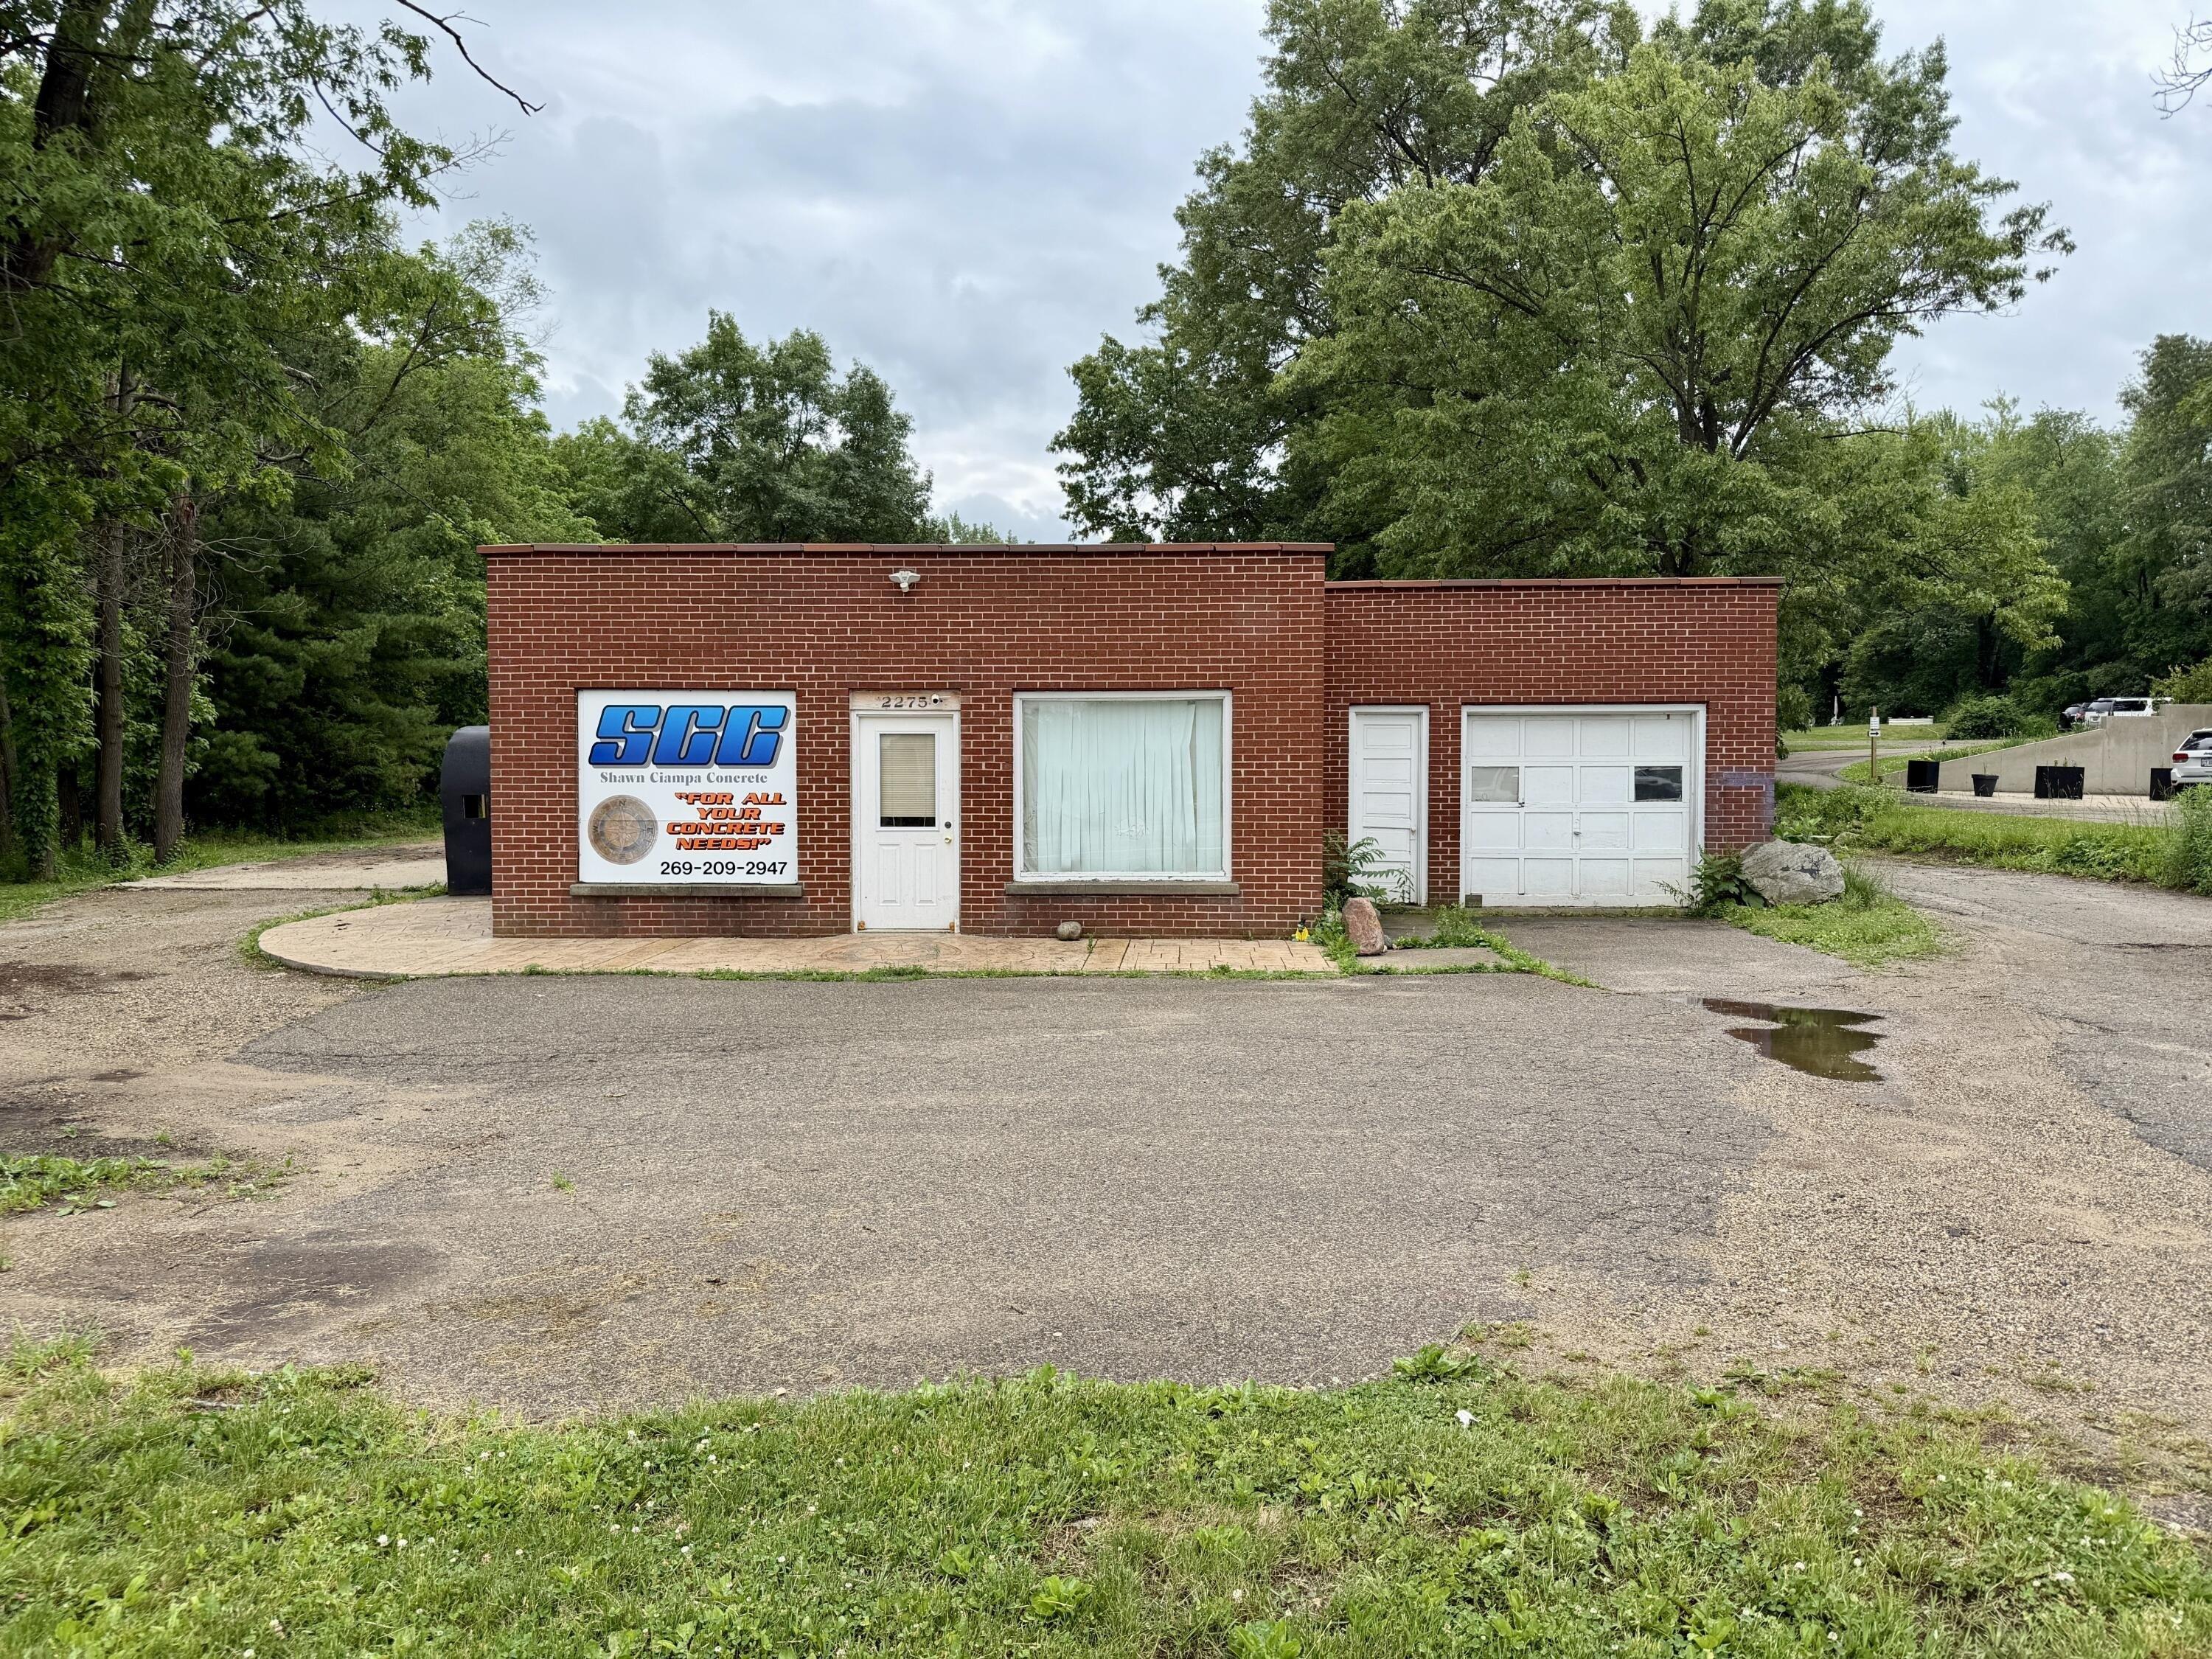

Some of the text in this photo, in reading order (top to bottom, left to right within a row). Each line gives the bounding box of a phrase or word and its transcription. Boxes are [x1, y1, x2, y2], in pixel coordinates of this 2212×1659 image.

[881, 696, 928, 708] 2275
[588, 704, 790, 768] SCC
[600, 771, 768, 786] Shawn Ciampa Concrete
[674, 792, 787, 805] "FOR ALL
[697, 807, 761, 820] YOUR
[666, 822, 785, 835] CONCRETE
[675, 838, 771, 850] NEEDS!"
[661, 861, 787, 875] 269-209-2947
